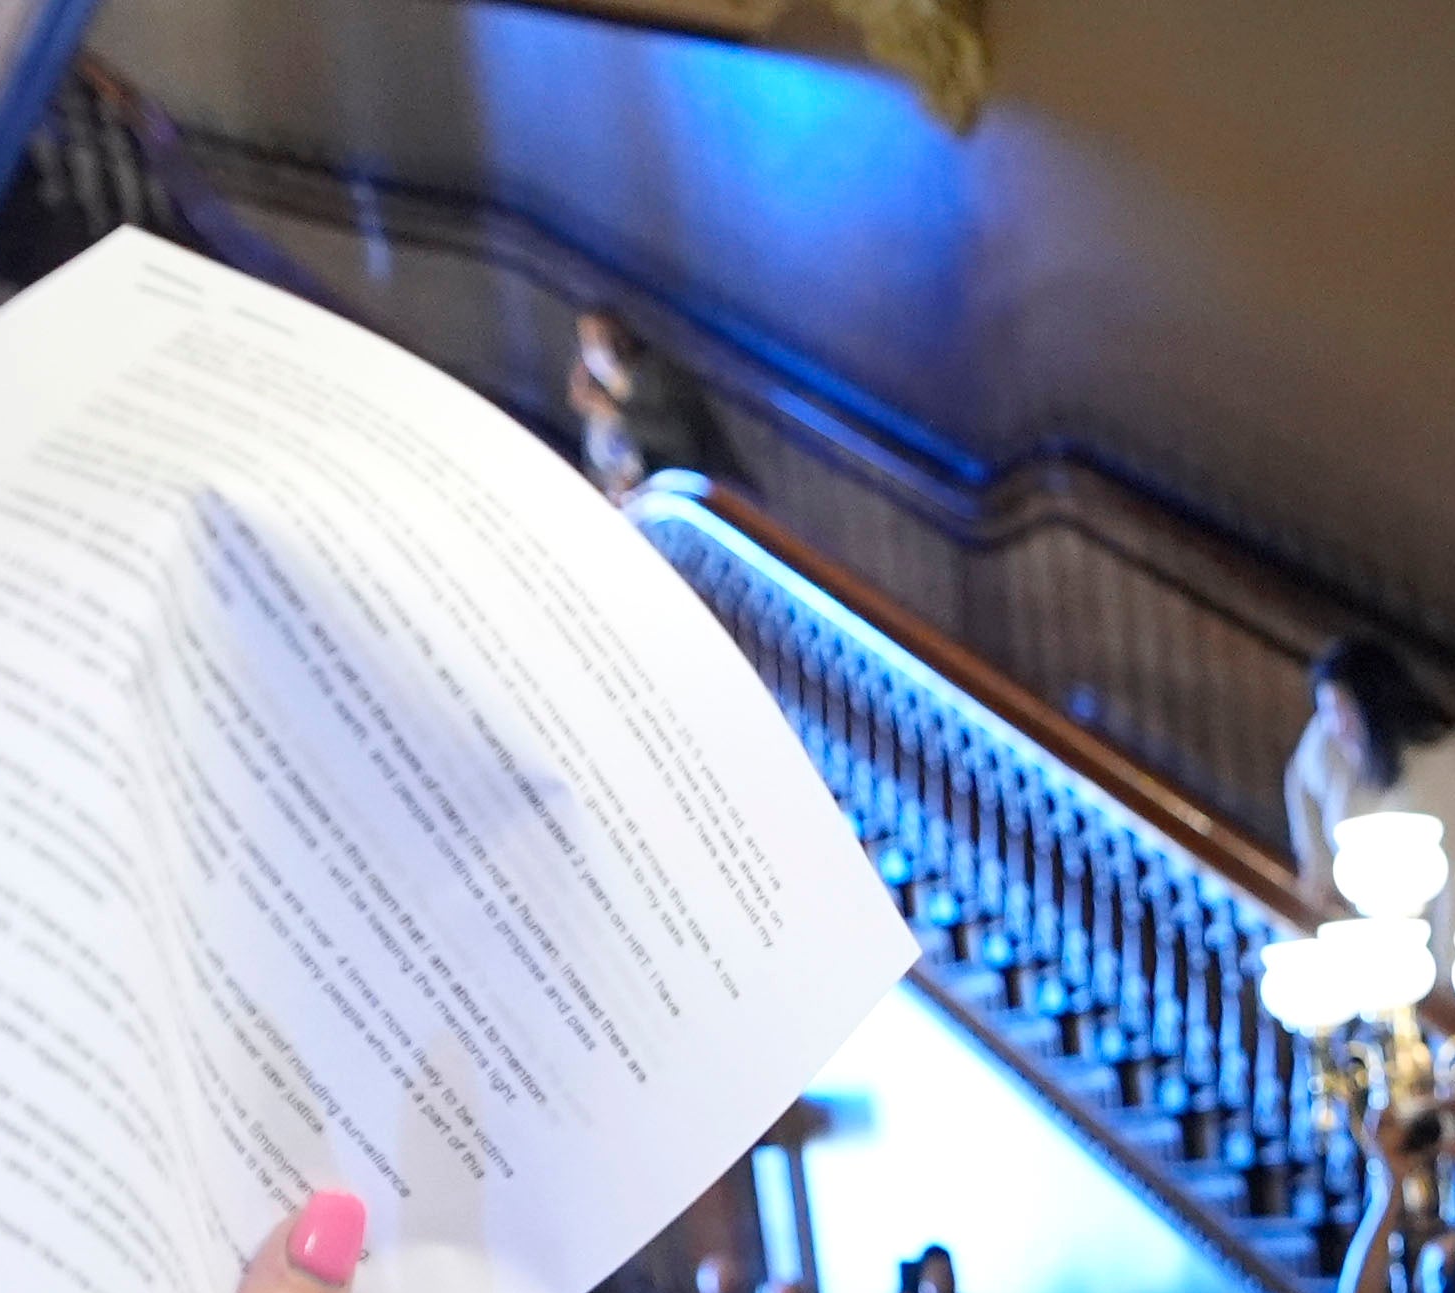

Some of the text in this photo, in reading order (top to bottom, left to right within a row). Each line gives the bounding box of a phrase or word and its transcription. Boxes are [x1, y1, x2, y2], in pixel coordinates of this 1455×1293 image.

[620, 712, 666, 770] wanted
[659, 769, 678, 789] to
[555, 751, 583, 782] and
[605, 826, 636, 865] back
[629, 865, 648, 885] to
[639, 884, 661, 910] my
[668, 787, 698, 822] stay
[691, 821, 721, 857] here
[696, 761, 729, 803] years
[742, 832, 766, 863] and
[464, 706, 518, 773] recently
[511, 769, 574, 854] celebrated
[576, 867, 613, 911] years
[608, 911, 627, 933] on
[652, 978, 683, 1018] have
[620, 814, 640, 835] all
[665, 885, 690, 914] this
[717, 969, 743, 1000] role
[715, 859, 740, 887] and
[732, 887, 762, 924] build
[733, 857, 774, 910] always
[767, 909, 785, 928] on
[430, 791, 469, 835] many
[483, 859, 510, 889] not
[598, 1019, 633, 1058] there
[625, 1058, 648, 1084] are
[431, 832, 487, 899] continue
[481, 900, 501, 920] to
[494, 919, 547, 984] propose
[542, 982, 572, 1015] and
[564, 1014, 596, 1050] pass
[753, 924, 775, 949] my
[396, 910, 426, 945] that
[428, 953, 451, 980] am
[448, 979, 488, 1025] about
[482, 1024, 502, 1044] to
[496, 1043, 549, 1105] mention
[411, 970, 438, 999] the
[433, 997, 491, 1068] mentions
[253, 1013, 292, 1057] proof
[283, 1052, 343, 1116] including
[337, 1112, 413, 1201] surveillance
[319, 978, 368, 1032] people
[362, 1028, 395, 1064] who
[390, 1062, 415, 1090] are
[419, 1101, 452, 1137] part
[446, 1132, 466, 1153] of
[459, 1149, 487, 1180] this
[377, 1007, 413, 1048] more
[406, 1046, 446, 1089] likely
[439, 1085, 459, 1106] to
[453, 1104, 476, 1128] be
[470, 1126, 516, 1179] victims
[243, 1119, 319, 1198] Employmen
